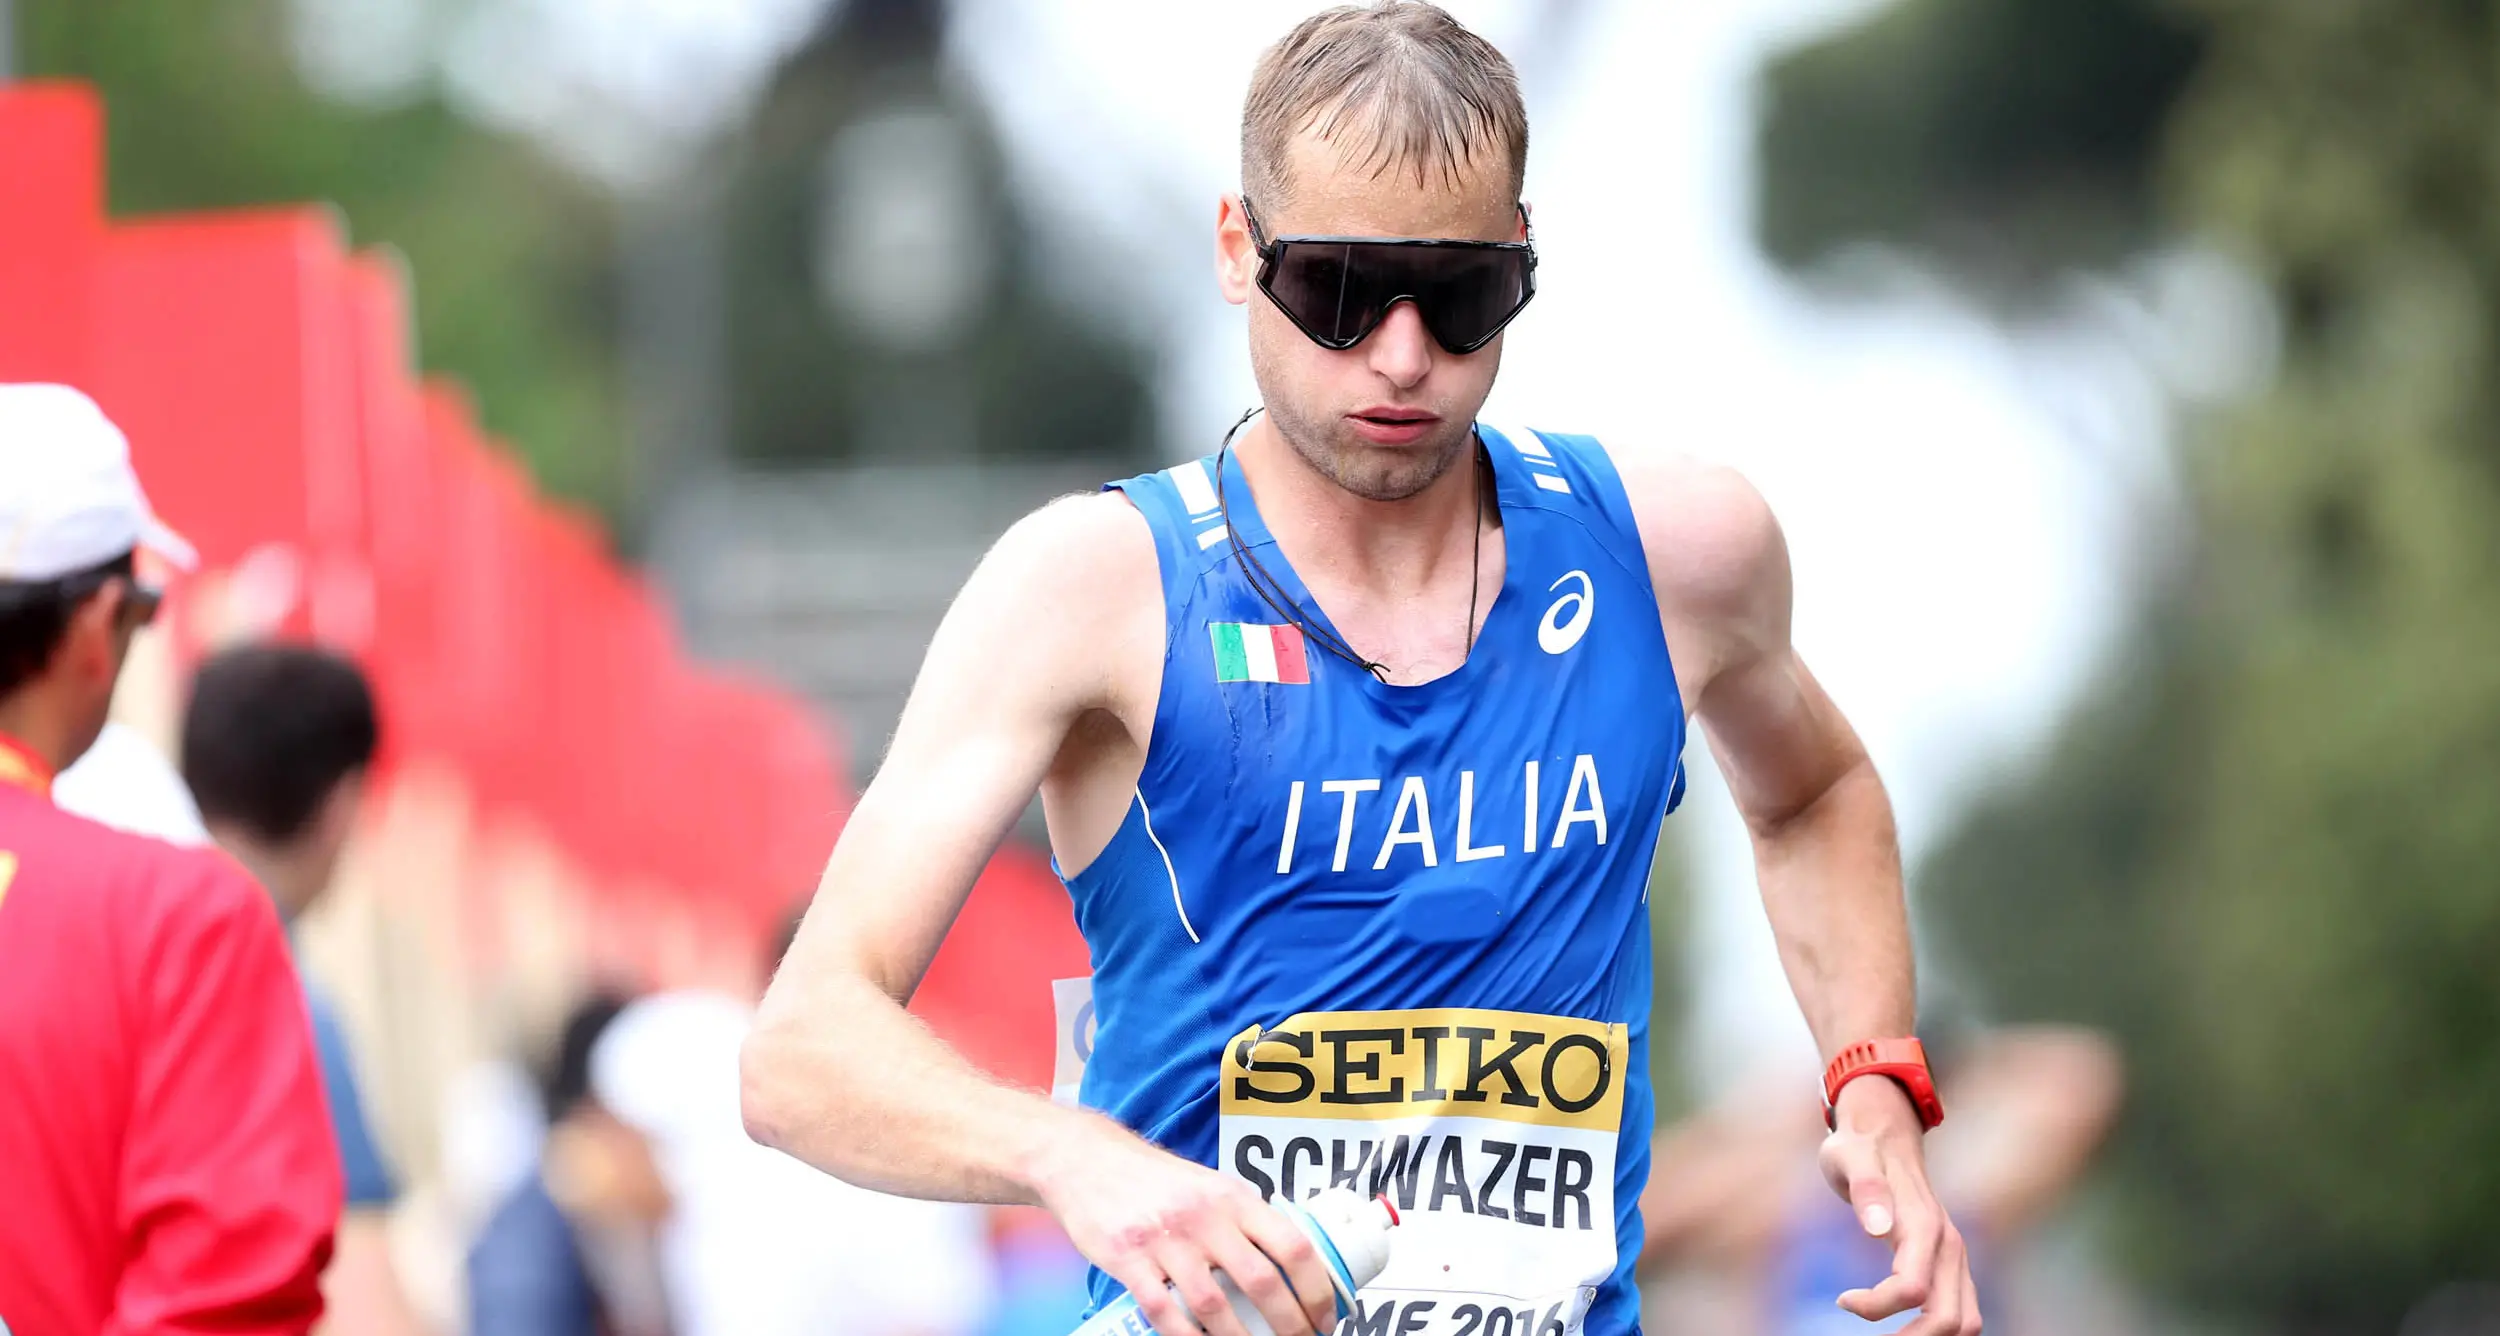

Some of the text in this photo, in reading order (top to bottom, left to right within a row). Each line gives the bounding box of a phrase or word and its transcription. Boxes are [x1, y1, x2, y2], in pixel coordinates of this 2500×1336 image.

[1276, 754, 1608, 874] ITALIA
[1235, 1027, 1611, 1113] SEIKO
[1331, 1299, 1564, 1336] ME 2016
